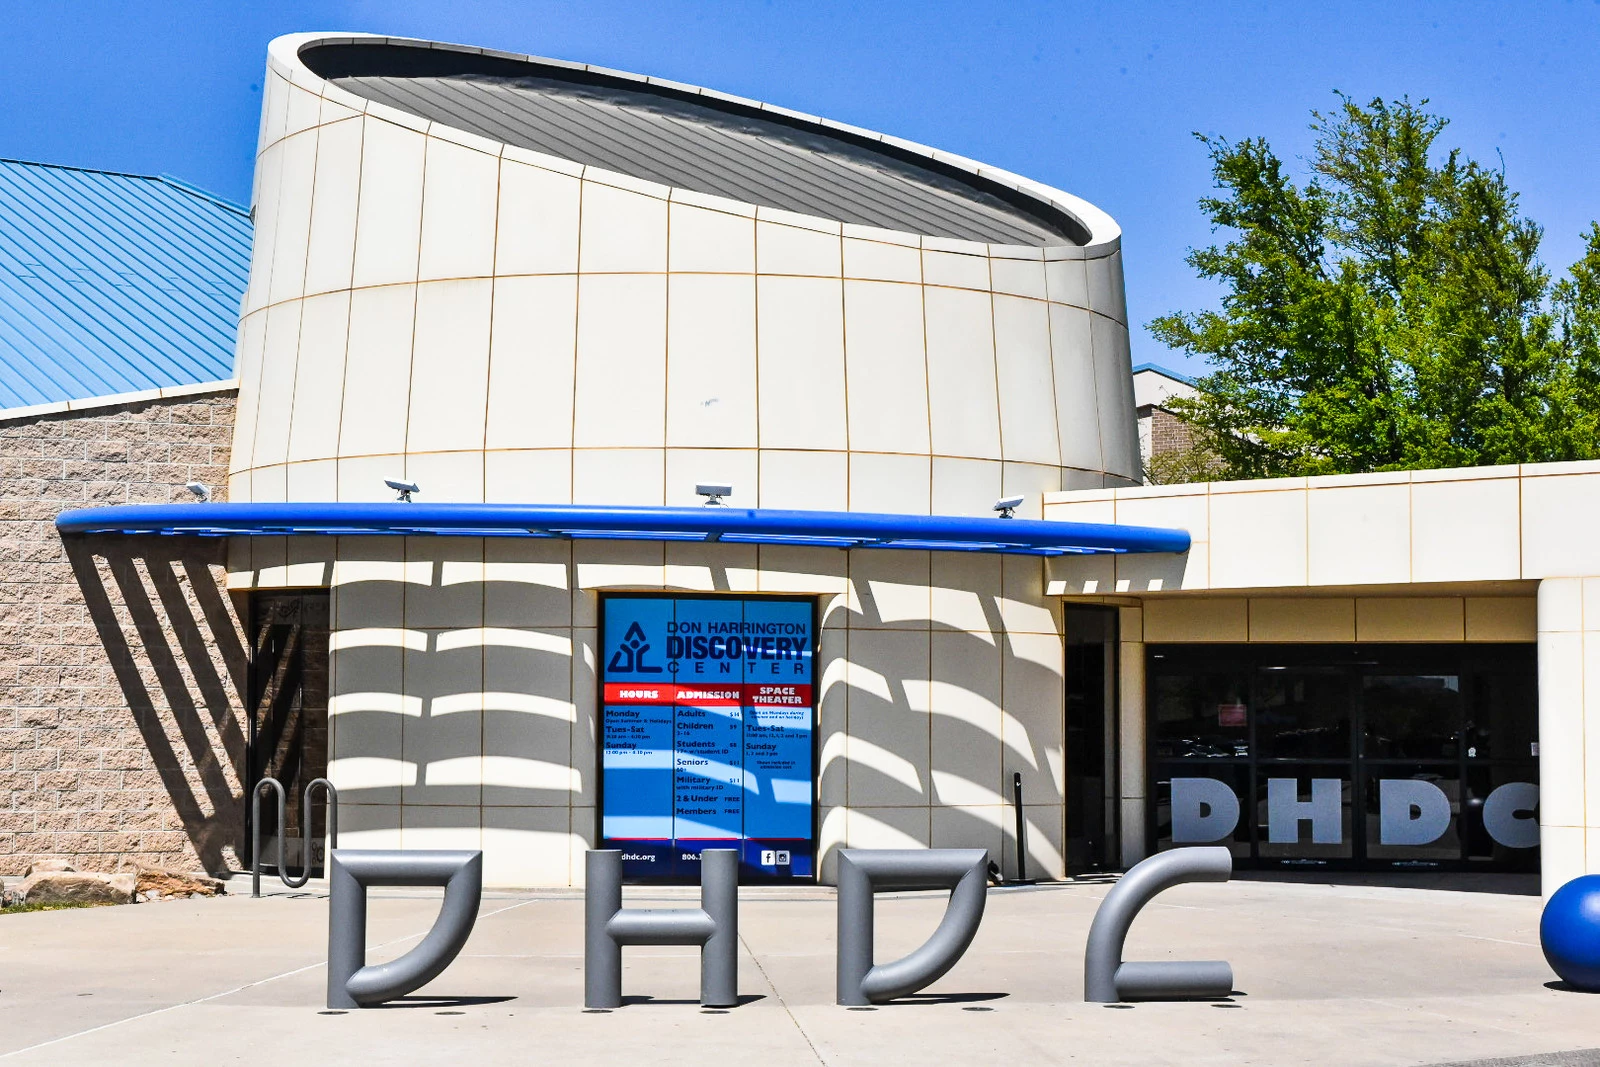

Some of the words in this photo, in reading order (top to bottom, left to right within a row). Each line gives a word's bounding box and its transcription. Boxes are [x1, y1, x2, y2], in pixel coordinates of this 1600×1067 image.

[667, 622, 701, 634] DON
[708, 622, 806, 635] HARRINGTON
[666, 635, 808, 660] DISCOVERY
[667, 662, 804, 674] CENTER
[619, 690, 659, 699] HOURS
[677, 690, 740, 699] ADMISSION
[760, 687, 795, 695] SPACE
[752, 695, 802, 704] THEATER
[606, 710, 640, 718] Monday
[606, 742, 636, 750] Sunday
[746, 743, 776, 751] Sunday
[676, 776, 710, 784] Military
[622, 854, 655, 862] dhdc.org
